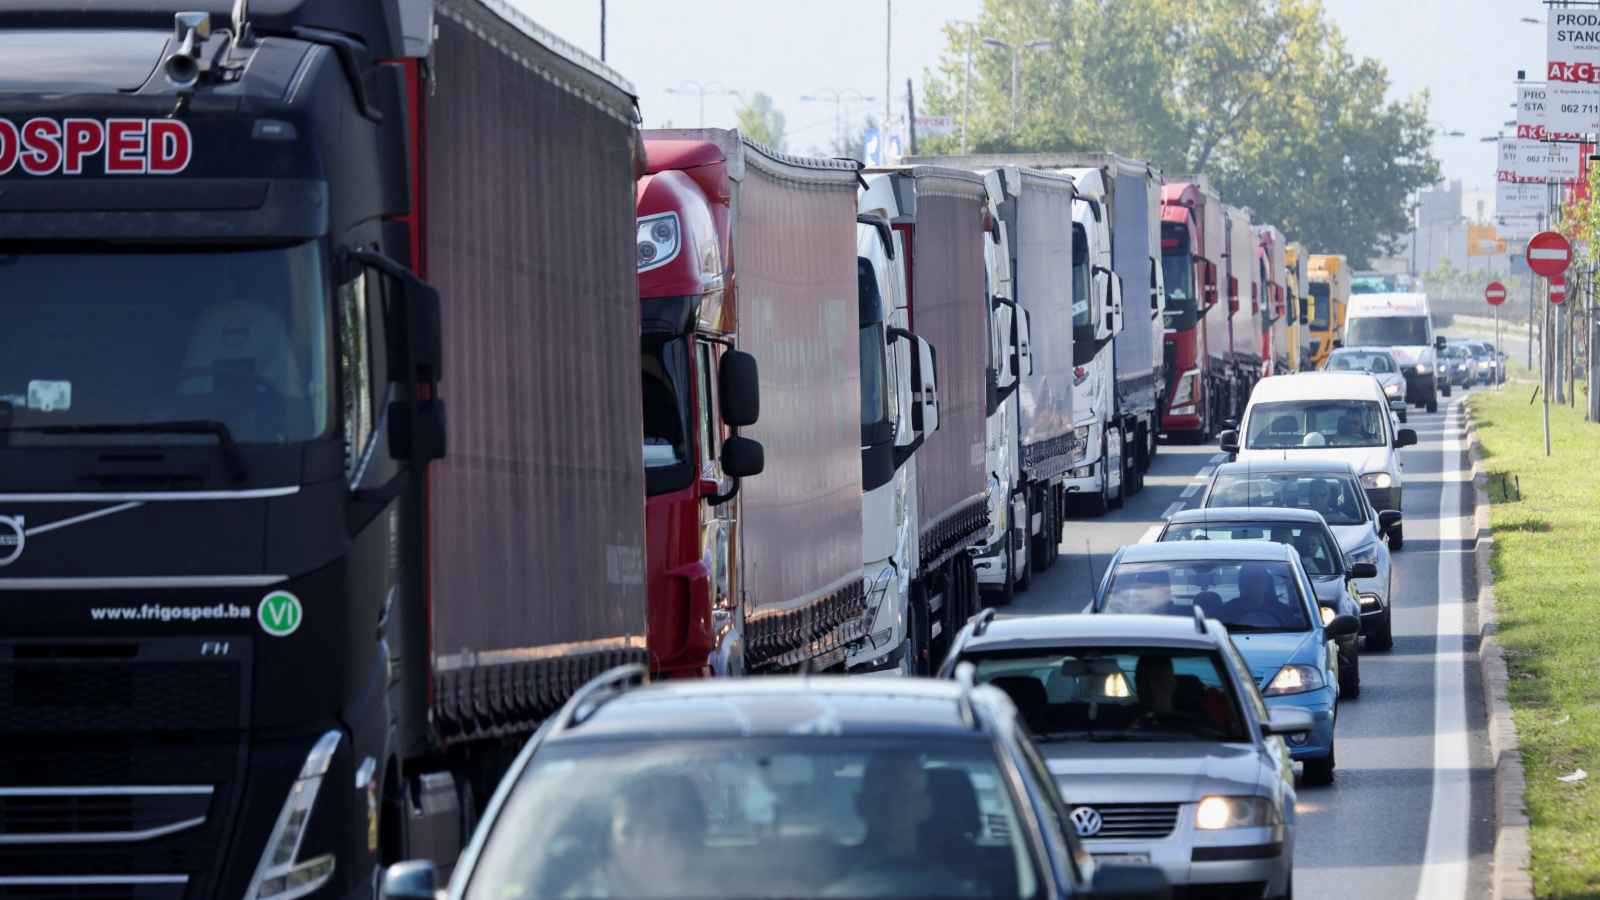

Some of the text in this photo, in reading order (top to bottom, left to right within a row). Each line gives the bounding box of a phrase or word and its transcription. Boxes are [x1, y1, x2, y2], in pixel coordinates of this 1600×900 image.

[1557, 14, 1600, 26] PROD
[91, 602, 251, 621] www.frigosped.ba
[200, 641, 230, 655] FH
